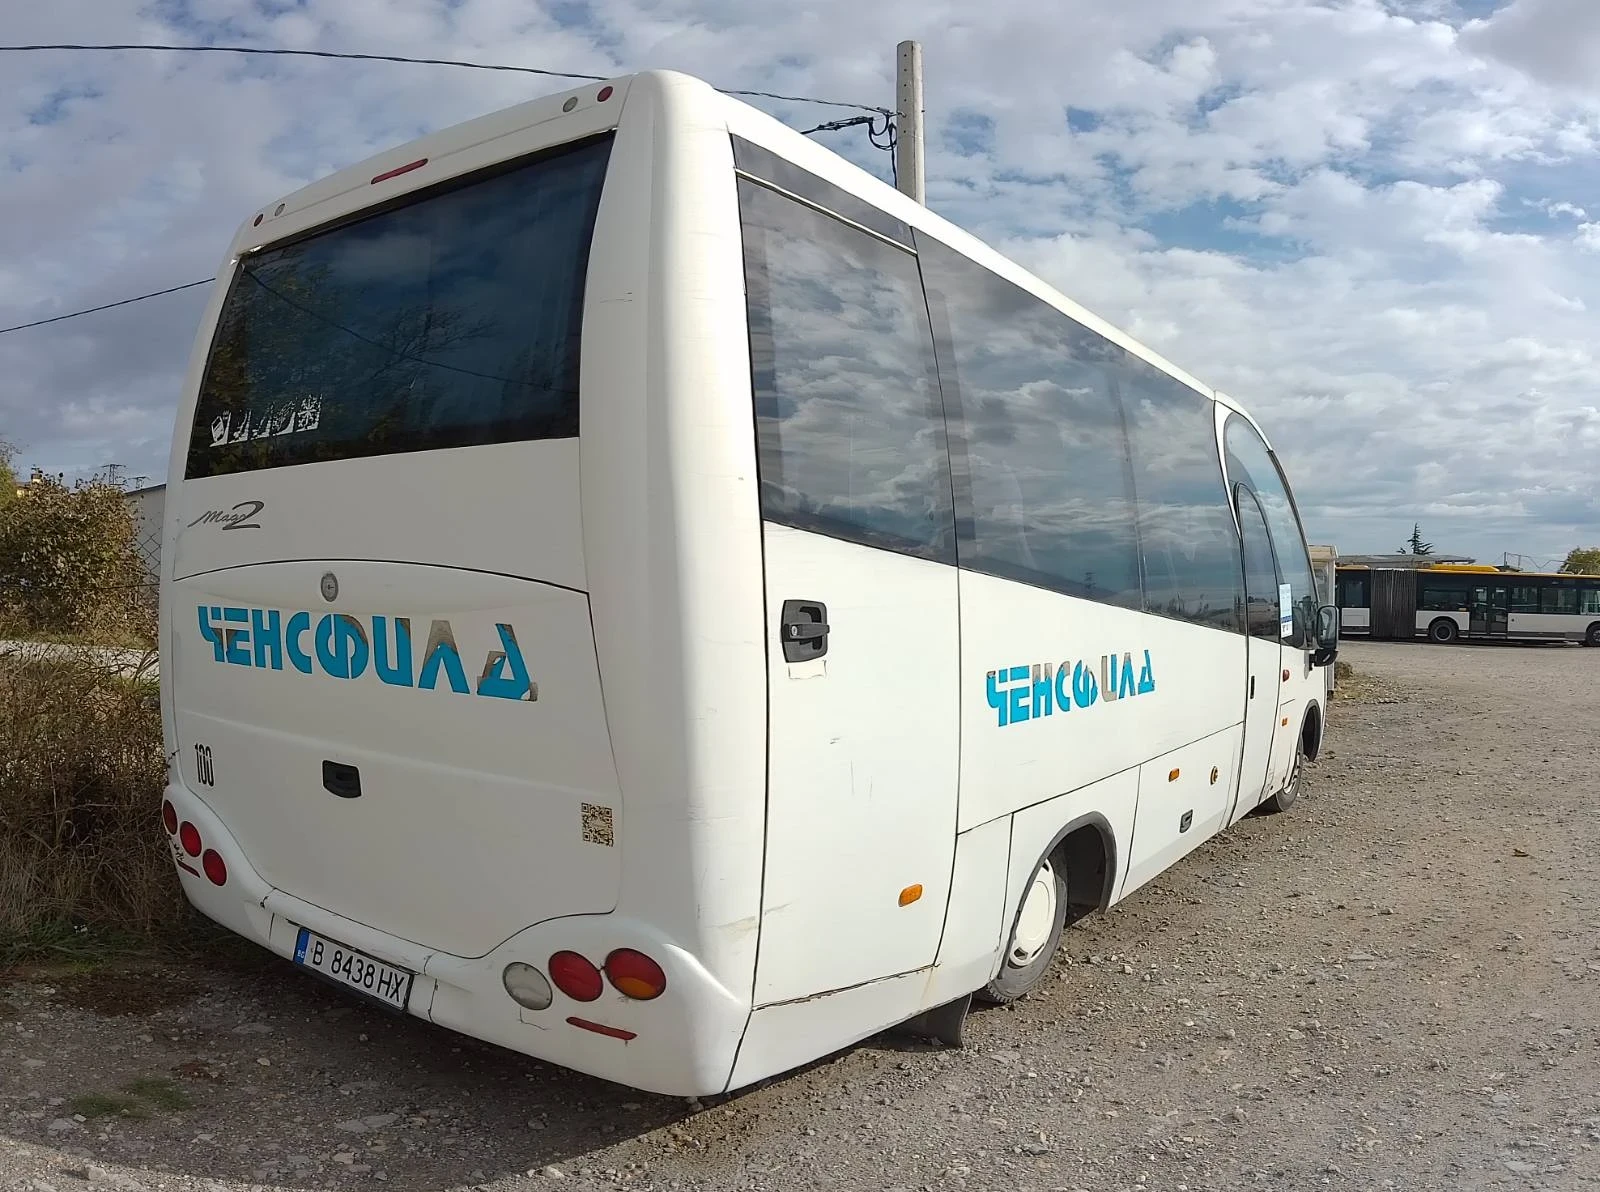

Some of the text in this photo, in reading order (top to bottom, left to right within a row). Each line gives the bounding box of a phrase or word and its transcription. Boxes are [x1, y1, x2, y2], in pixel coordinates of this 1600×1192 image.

[197, 605, 538, 701] ЧЕНСФИЛД
[986, 649, 1156, 727] ЧЕНСФИЛД
[194, 743, 214, 787] 100
[331, 950, 376, 989] 8438
